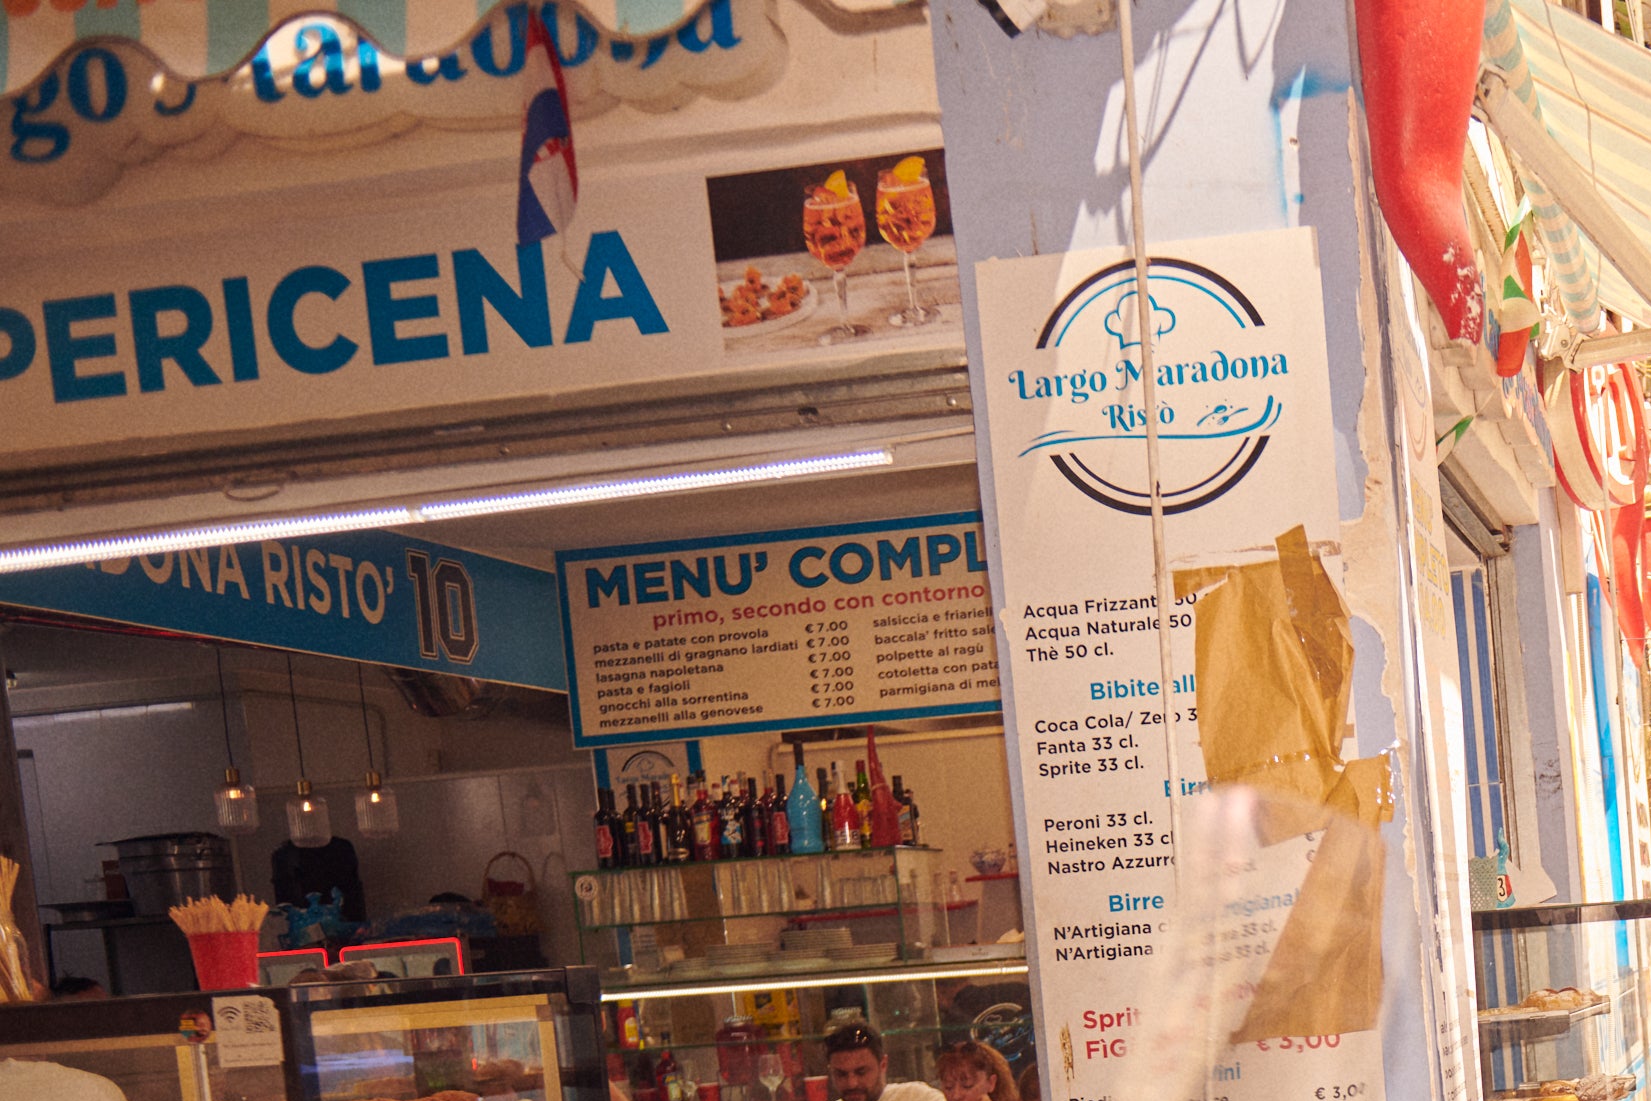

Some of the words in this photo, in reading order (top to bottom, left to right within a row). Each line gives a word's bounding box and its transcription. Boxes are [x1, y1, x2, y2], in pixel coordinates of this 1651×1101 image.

[1007, 368, 1108, 404] Largo
[1115, 349, 1290, 393] Maradona
[585, 551, 768, 608] MENU'
[789, 531, 988, 588] COMPL
[261, 540, 395, 625] RISTO'
[405, 548, 480, 664] 10
[653, 608, 724, 631] primo,
[732, 597, 827, 621] secondo
[834, 595, 874, 611] con
[883, 584, 985, 606] contorno
[1024, 605, 1079, 619] Acqua
[1085, 594, 1159, 614] Frizzant
[817, 620, 848, 631] 7.00
[873, 613, 929, 628] salsiccia
[933, 613, 941, 621] e
[1025, 627, 1080, 641] Acqua
[1087, 616, 1160, 635] Naturale
[1169, 613, 1192, 628] 50
[593, 642, 629, 655] pasta
[632, 642, 641, 650] e
[644, 637, 687, 650] patate
[691, 634, 715, 644] con
[719, 628, 768, 643] provola
[818, 635, 850, 647] 7.00
[874, 631, 929, 646] baccala'
[934, 628, 968, 641] fritto
[594, 653, 664, 668] mezzanelli
[669, 652, 681, 662] di
[686, 646, 748, 662] gragnano
[752, 639, 799, 654] lardiati
[820, 651, 851, 662] 7.00
[877, 646, 934, 664] polpette
[938, 646, 951, 657] al
[954, 642, 984, 657] ragù
[1026, 646, 1059, 662] Thè
[1065, 644, 1088, 659] 50
[1094, 642, 1114, 657] cl.
[596, 669, 646, 684] lasagna
[650, 663, 724, 679] napoletana
[823, 666, 854, 678] 7.00
[878, 665, 939, 680] cotoletta
[943, 663, 968, 674] con
[597, 687, 633, 700] pasta
[636, 687, 645, 695] e
[649, 680, 691, 695] fagioli
[823, 681, 854, 692] 7.00
[880, 682, 955, 698] parmigiana
[959, 678, 972, 689] di
[1090, 678, 1160, 701] Bibite
[599, 699, 651, 715] gnocchi
[655, 696, 678, 708] alla
[682, 690, 749, 706] sorrentina
[824, 695, 855, 707] 7.00
[599, 712, 669, 728] mezzanelli
[673, 707, 697, 720] alla
[700, 704, 764, 720] genovese
[1035, 719, 1079, 733] Coca
[1085, 711, 1133, 730] Cola/
[1037, 741, 1086, 755] Fanta
[1092, 737, 1113, 751] 33
[1120, 734, 1139, 749] cl.
[1039, 761, 1092, 779] Sprite
[1098, 758, 1118, 772] 33
[1125, 755, 1144, 770] cl.
[1044, 815, 1100, 832] Peroni
[1107, 813, 1127, 827] 33
[1134, 811, 1153, 826] cl.
[1046, 836, 1127, 854] Heineken
[1134, 833, 1154, 847] 33
[1048, 860, 1106, 875] Nastro
[1497, 877, 1506, 897] 3
[1108, 893, 1165, 912] Birre
[1054, 923, 1152, 940] N'Artigiana
[1056, 944, 1153, 961] N'Artigiana
[1212, 1062, 1242, 1081] ini
[1315, 1087, 1326, 1100] €
